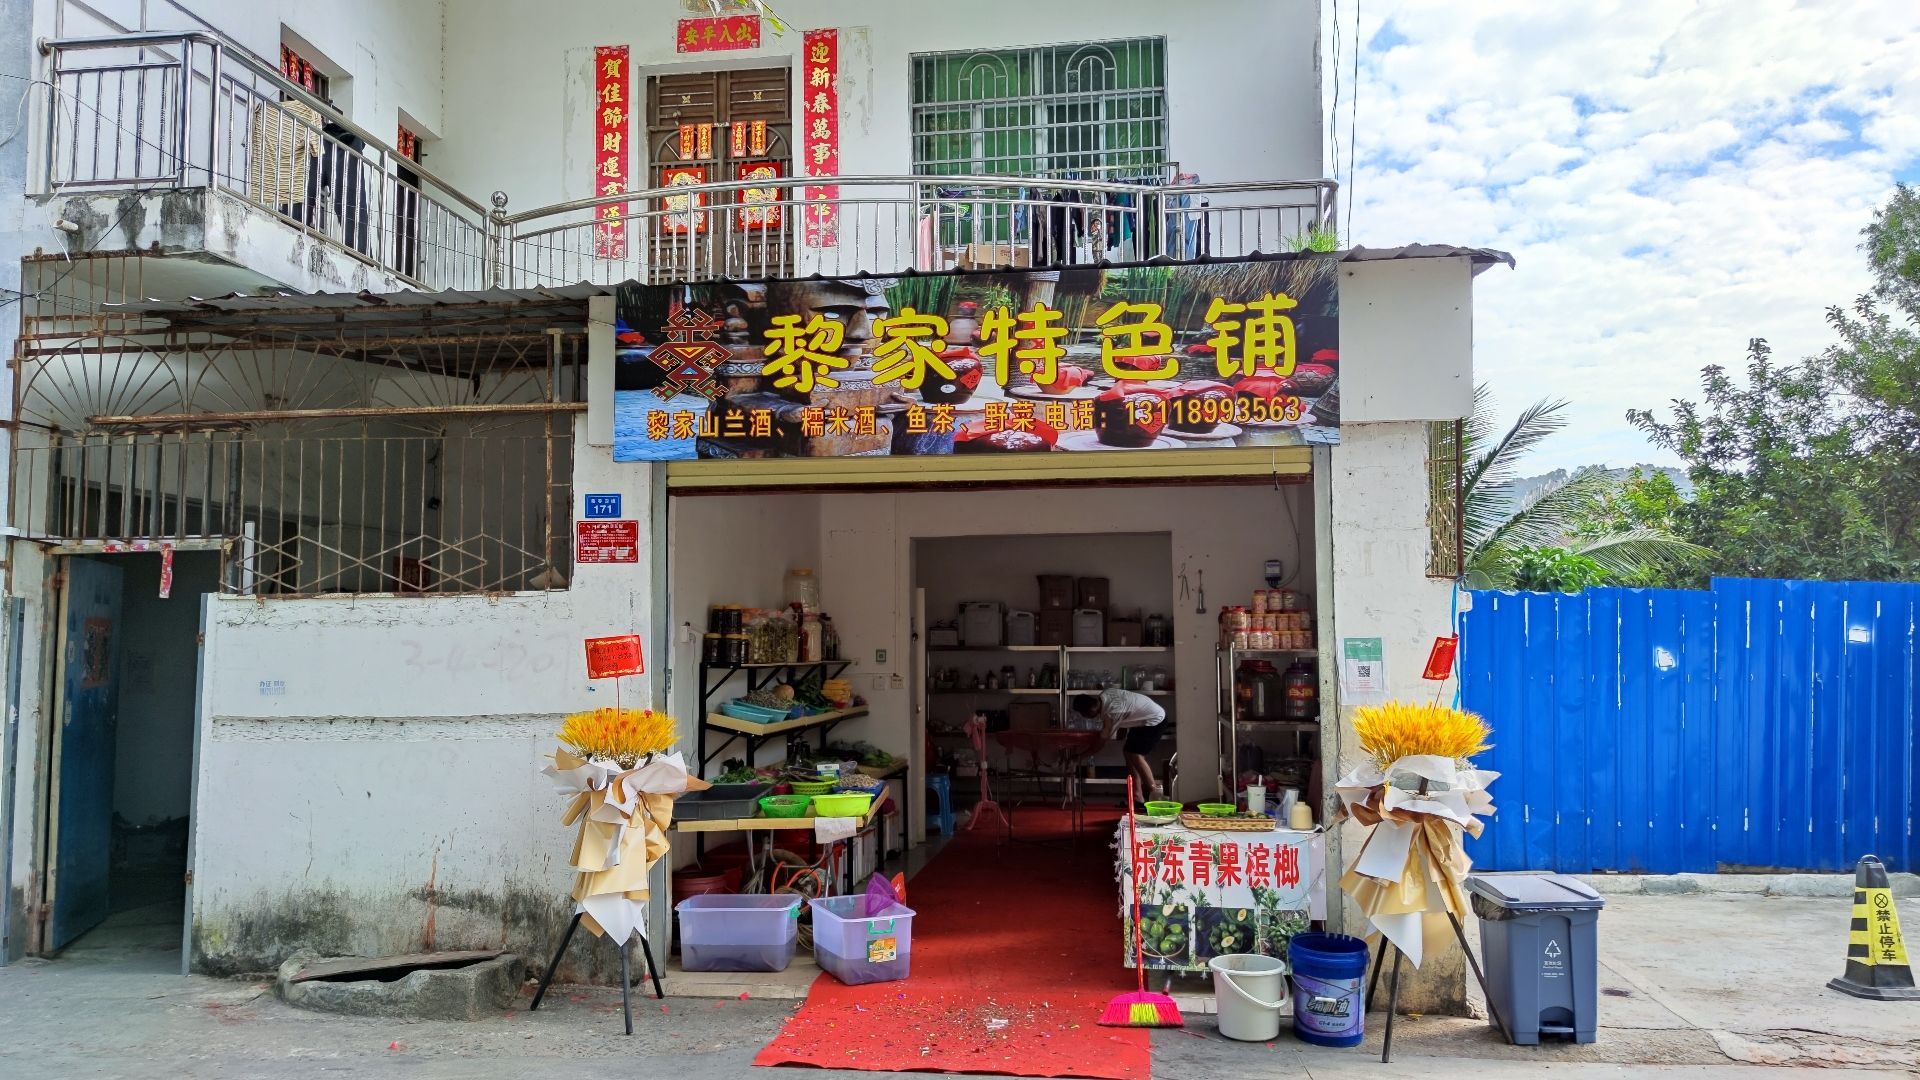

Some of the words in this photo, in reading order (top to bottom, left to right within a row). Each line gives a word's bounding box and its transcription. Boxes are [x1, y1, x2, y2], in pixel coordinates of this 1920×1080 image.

[762, 292, 1299, 394] 黎家特色铺
[593, 504, 613, 515] 171
[1135, 838, 1301, 890] 乐东青果槟榔
[1875, 909, 1897, 962] 禁止停车
